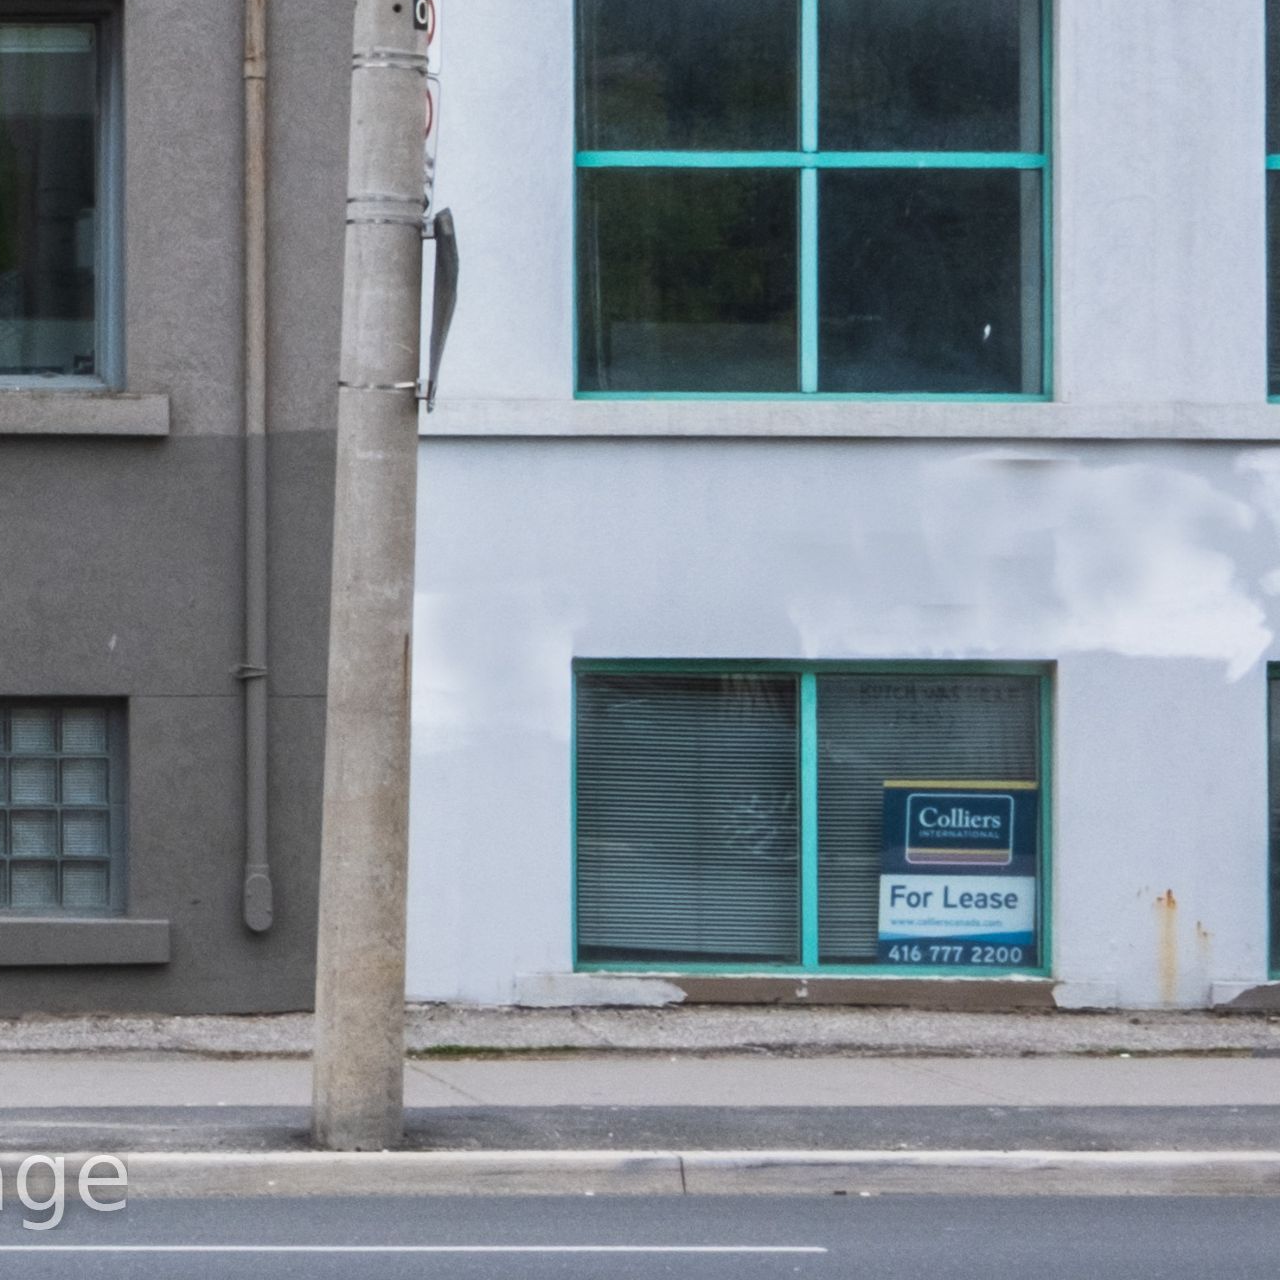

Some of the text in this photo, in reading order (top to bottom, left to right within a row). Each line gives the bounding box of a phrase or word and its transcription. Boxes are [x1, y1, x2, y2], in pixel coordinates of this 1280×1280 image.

[919, 807, 1002, 828] Colliers
[919, 830, 1000, 839] INTERNATIONAL
[890, 885, 1019, 909] For Lease
[889, 945, 1023, 963] 416 777 2200
